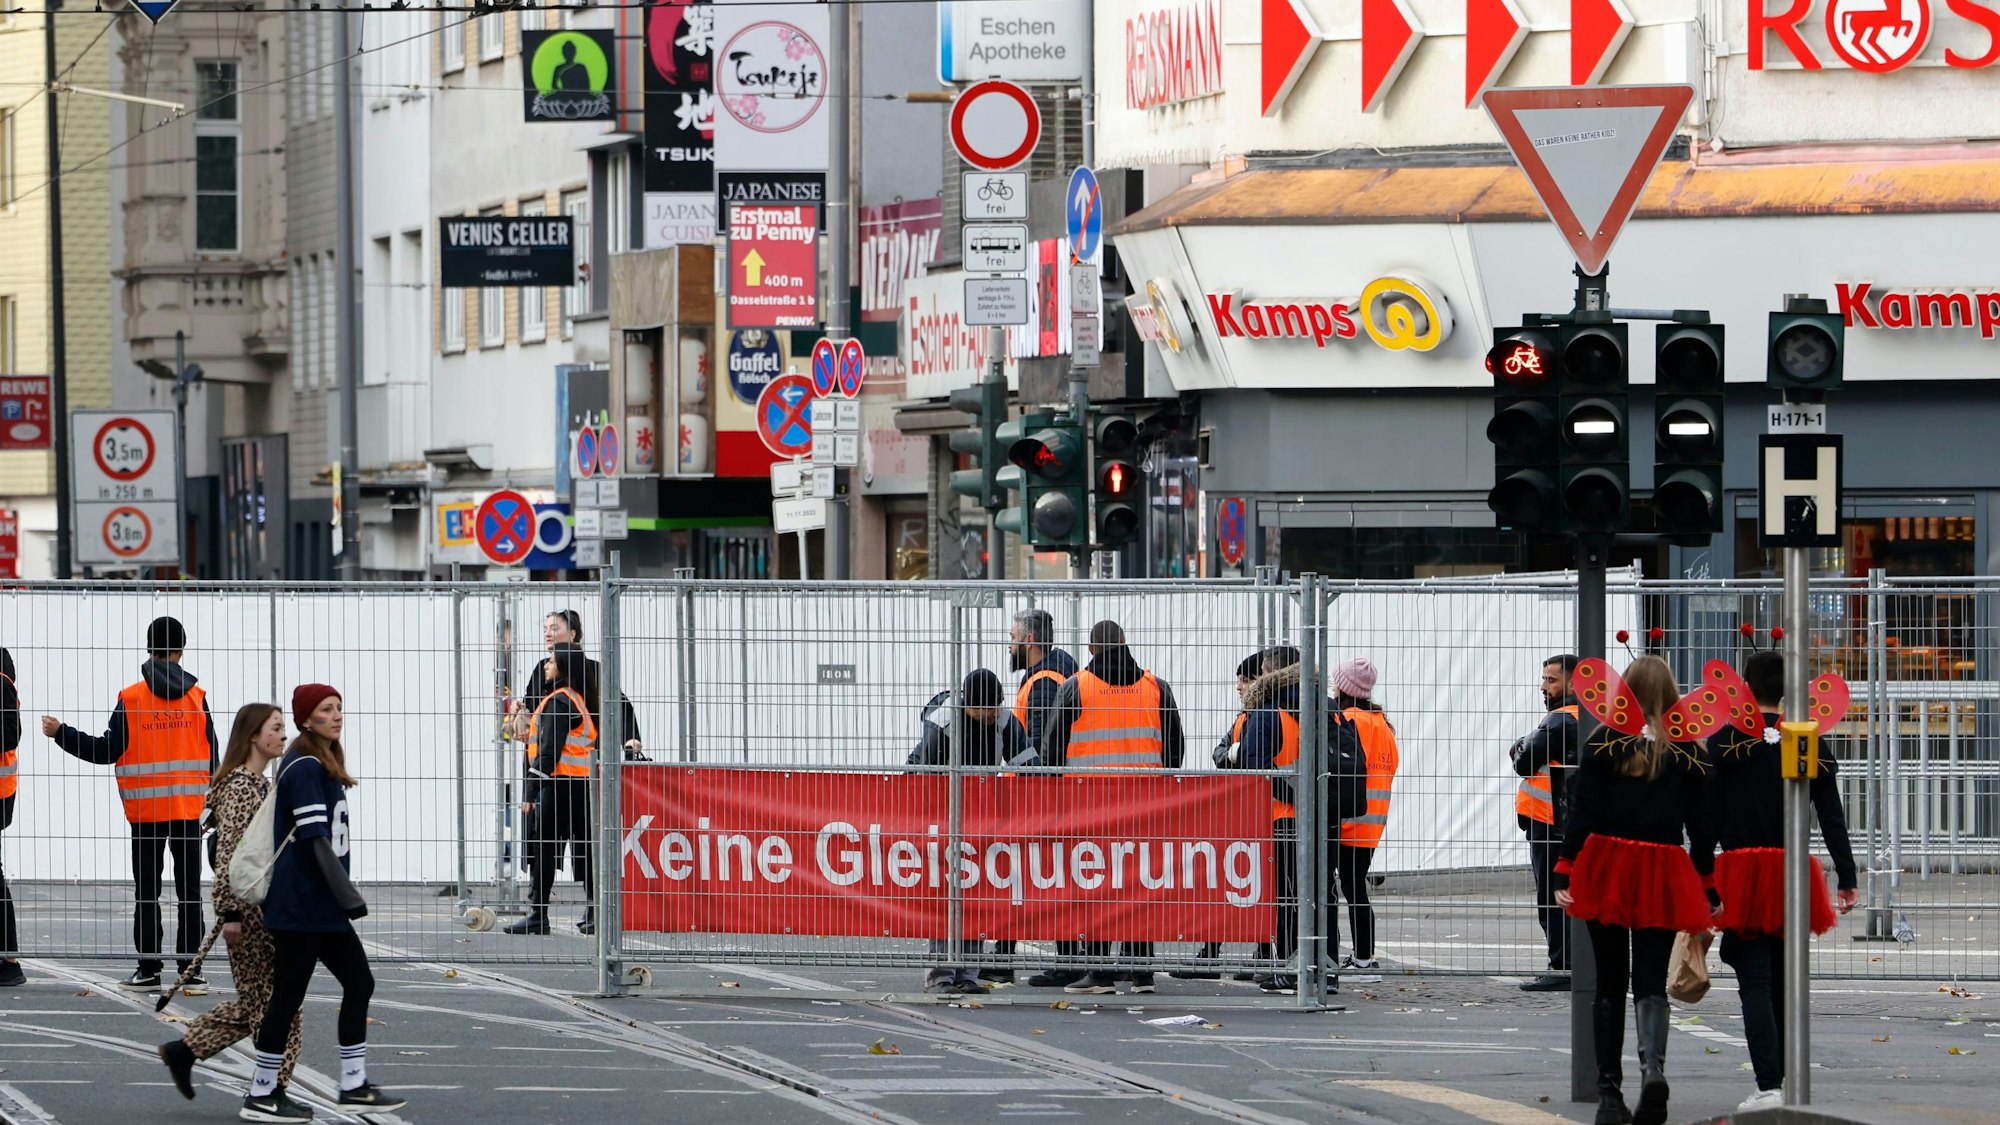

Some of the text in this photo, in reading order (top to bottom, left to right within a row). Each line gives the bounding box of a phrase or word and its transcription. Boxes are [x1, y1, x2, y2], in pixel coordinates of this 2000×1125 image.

[981, 17, 1055, 35] Eschen
[969, 42, 1066, 64] Apotheke
[1126, 0, 1222, 110] ROSSMANN
[1535, 139, 1545, 147] DAS
[1546, 136, 1564, 145] WAREN
[1565, 134, 1579, 143] KEINE
[1581, 131, 1600, 141] RATHER
[723, 183, 821, 200] JAPANESE
[731, 206, 802, 225] Erstmal
[987, 203, 1006, 214] frei
[448, 222, 568, 246] VENUS CELLER
[731, 224, 815, 244] zu Penny
[987, 256, 1006, 266] frei
[765, 275, 803, 286] 400 m
[731, 295, 815, 305] Dasselstraße 1 b
[1207, 294, 1358, 348] Kamps
[730, 352, 780, 371] Gaffel
[0, 381, 47, 395] REWE
[99, 485, 153, 499] in 250 m
[1765, 447, 1837, 535] H
[141, 721, 192, 731] SICHERHEIT
[620, 814, 1261, 907] Keine Gleisquerung
